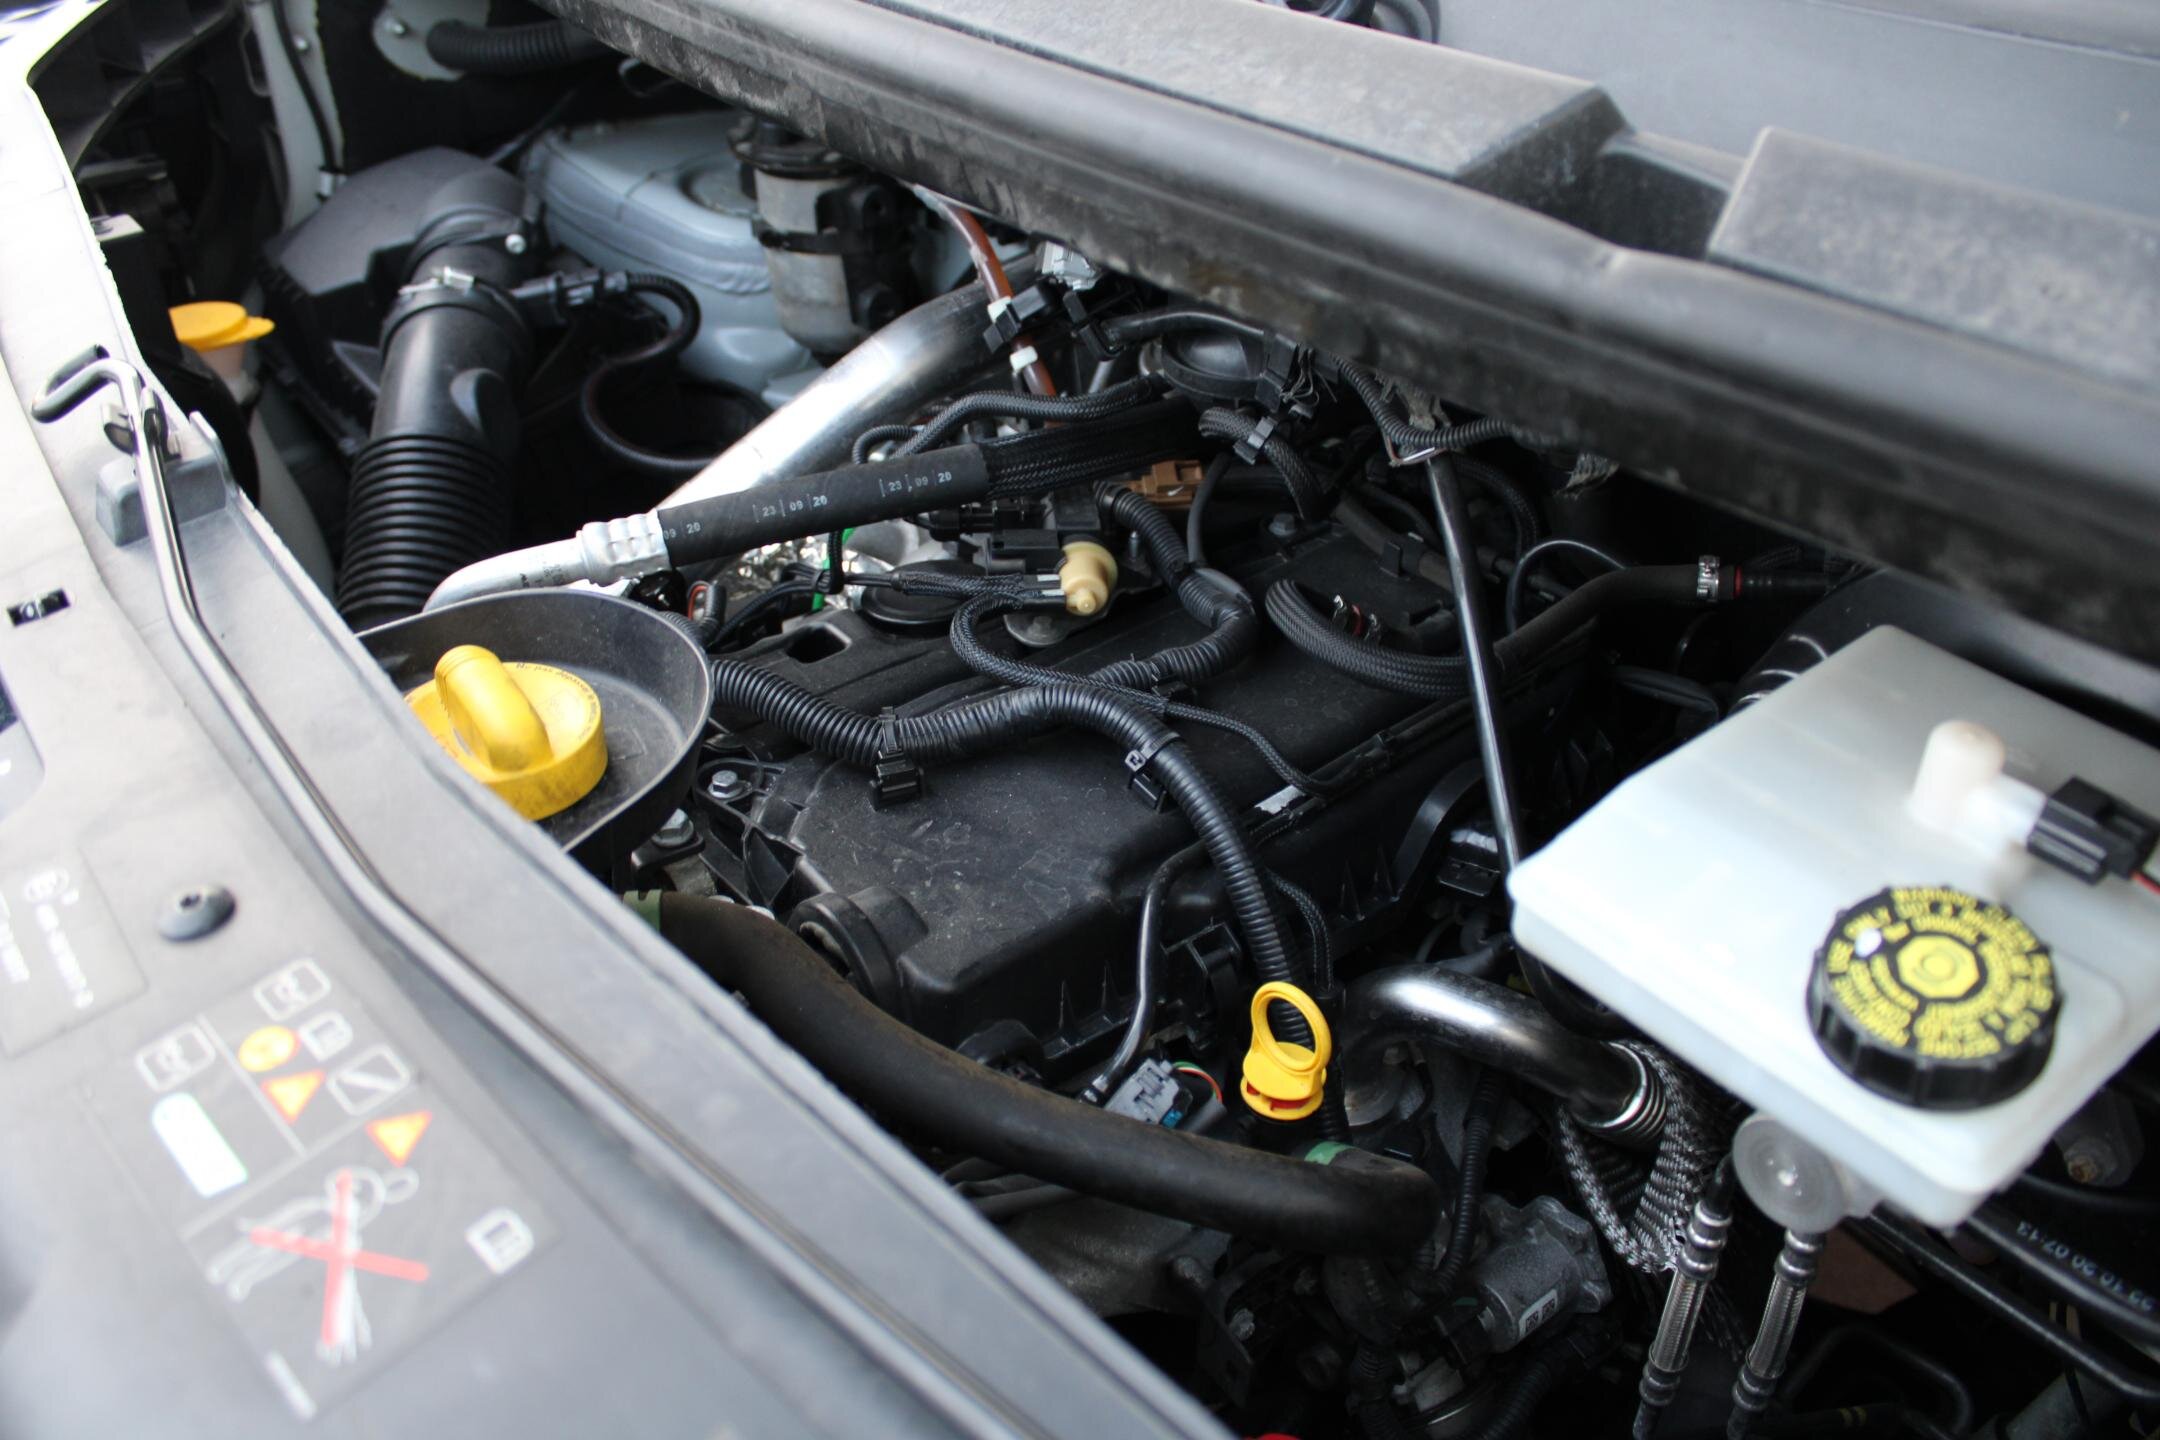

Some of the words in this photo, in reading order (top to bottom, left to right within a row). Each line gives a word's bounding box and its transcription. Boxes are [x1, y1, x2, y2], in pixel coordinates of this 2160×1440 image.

[888, 480, 902, 492] 23
[915, 476, 929, 487] 09
[938, 471, 953, 483] 20
[762, 505, 776, 517] 23
[789, 500, 804, 511] 09
[813, 495, 828, 507] 20
[687, 522, 700, 534] 20
